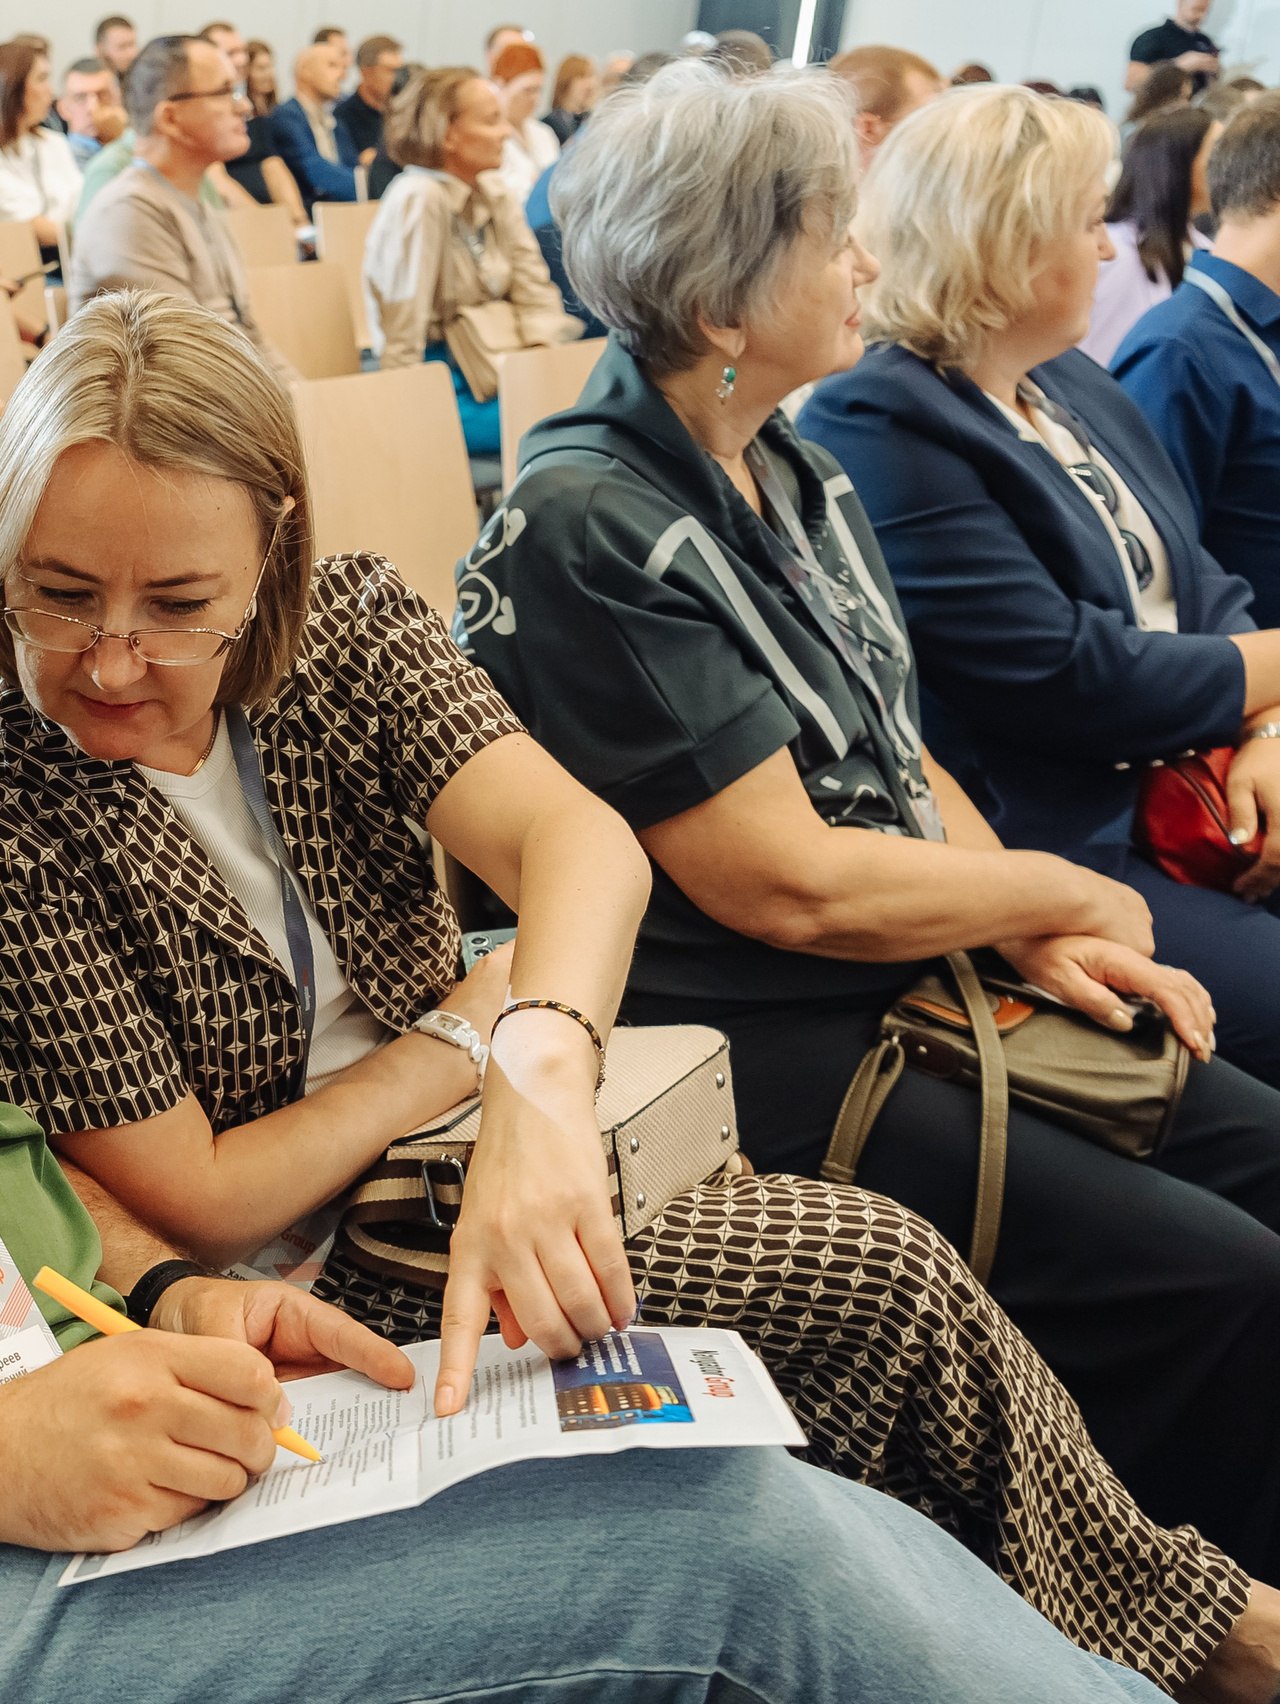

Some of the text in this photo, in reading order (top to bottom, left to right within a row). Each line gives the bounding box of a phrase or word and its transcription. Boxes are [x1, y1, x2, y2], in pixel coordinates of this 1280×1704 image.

[280, 1228, 317, 1255] Group
[689, 1348, 736, 1398] Navigator Group
